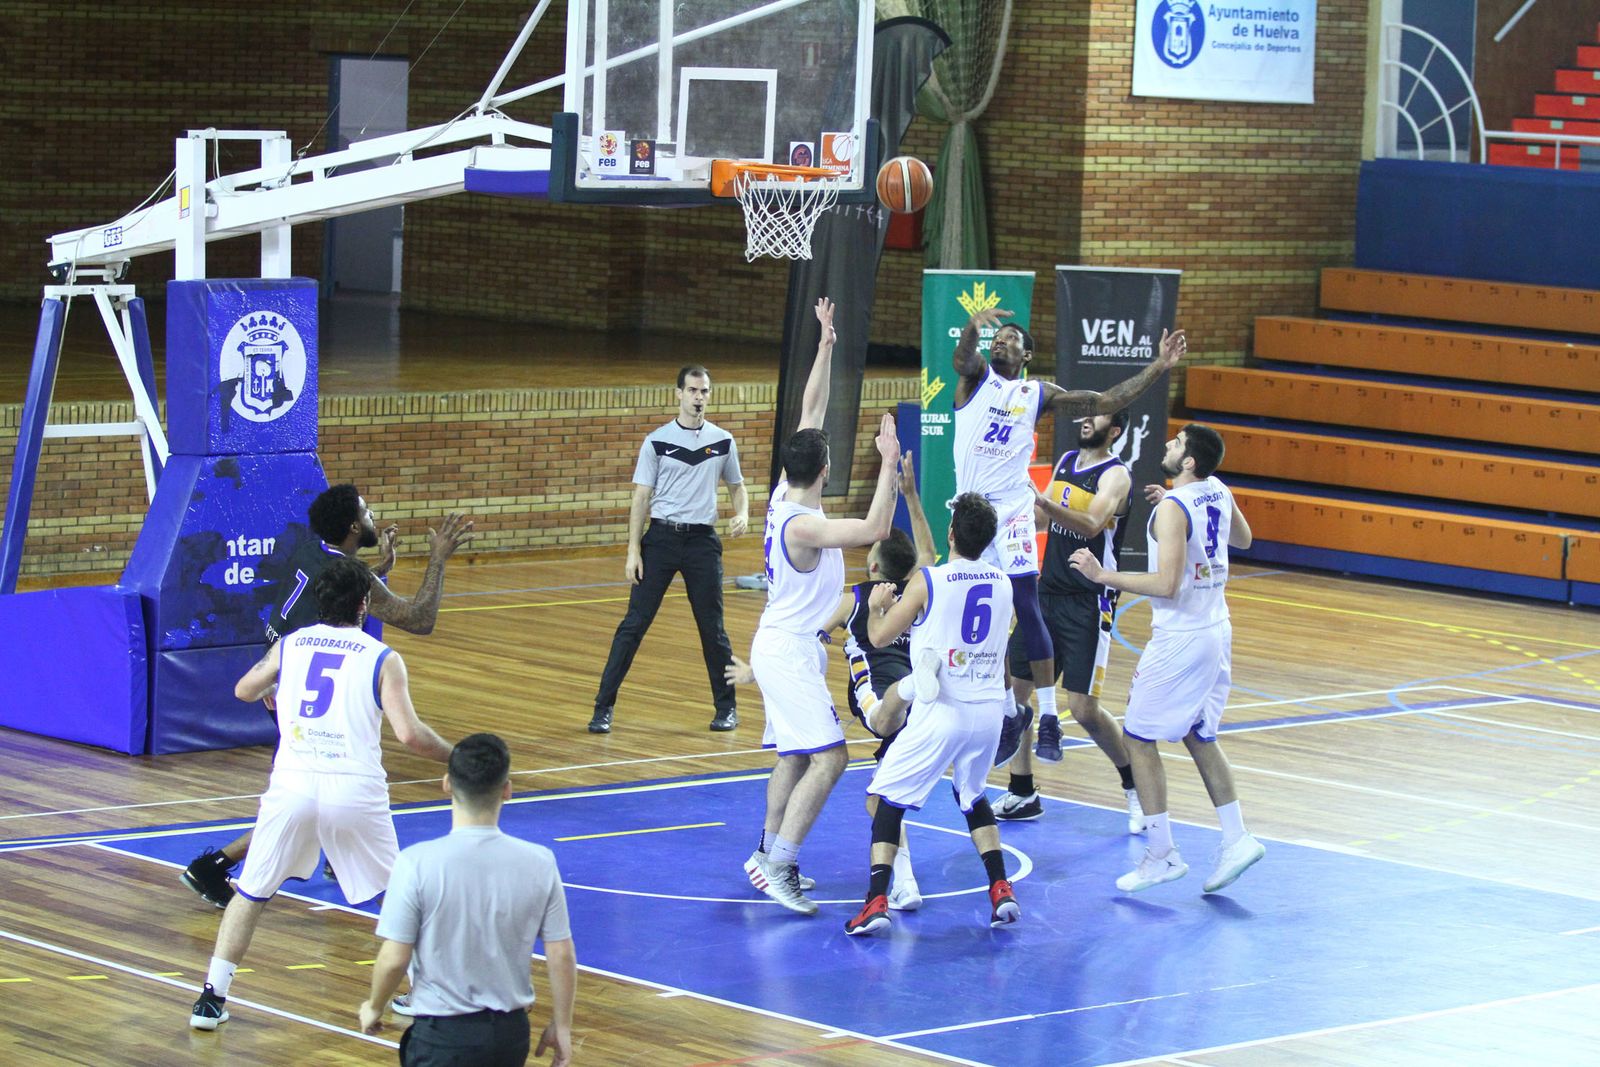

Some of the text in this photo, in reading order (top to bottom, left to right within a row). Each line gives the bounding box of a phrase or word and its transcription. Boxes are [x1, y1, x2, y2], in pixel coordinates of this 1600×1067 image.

[1208, 4, 1300, 22] Ayuntamiento
[1232, 23, 1300, 40] de Huelva
[1267, 43, 1302, 54] Deportes
[1082, 318, 1153, 345] VEN AL
[1081, 344, 1152, 358] BALONCESTO
[921, 426, 944, 435] SUR
[984, 422, 1012, 445] 24
[224, 562, 255, 585] de
[281, 568, 309, 620] 7
[961, 583, 993, 644] 6
[295, 637, 367, 653] CORDOBASKET
[299, 651, 346, 719] 5
